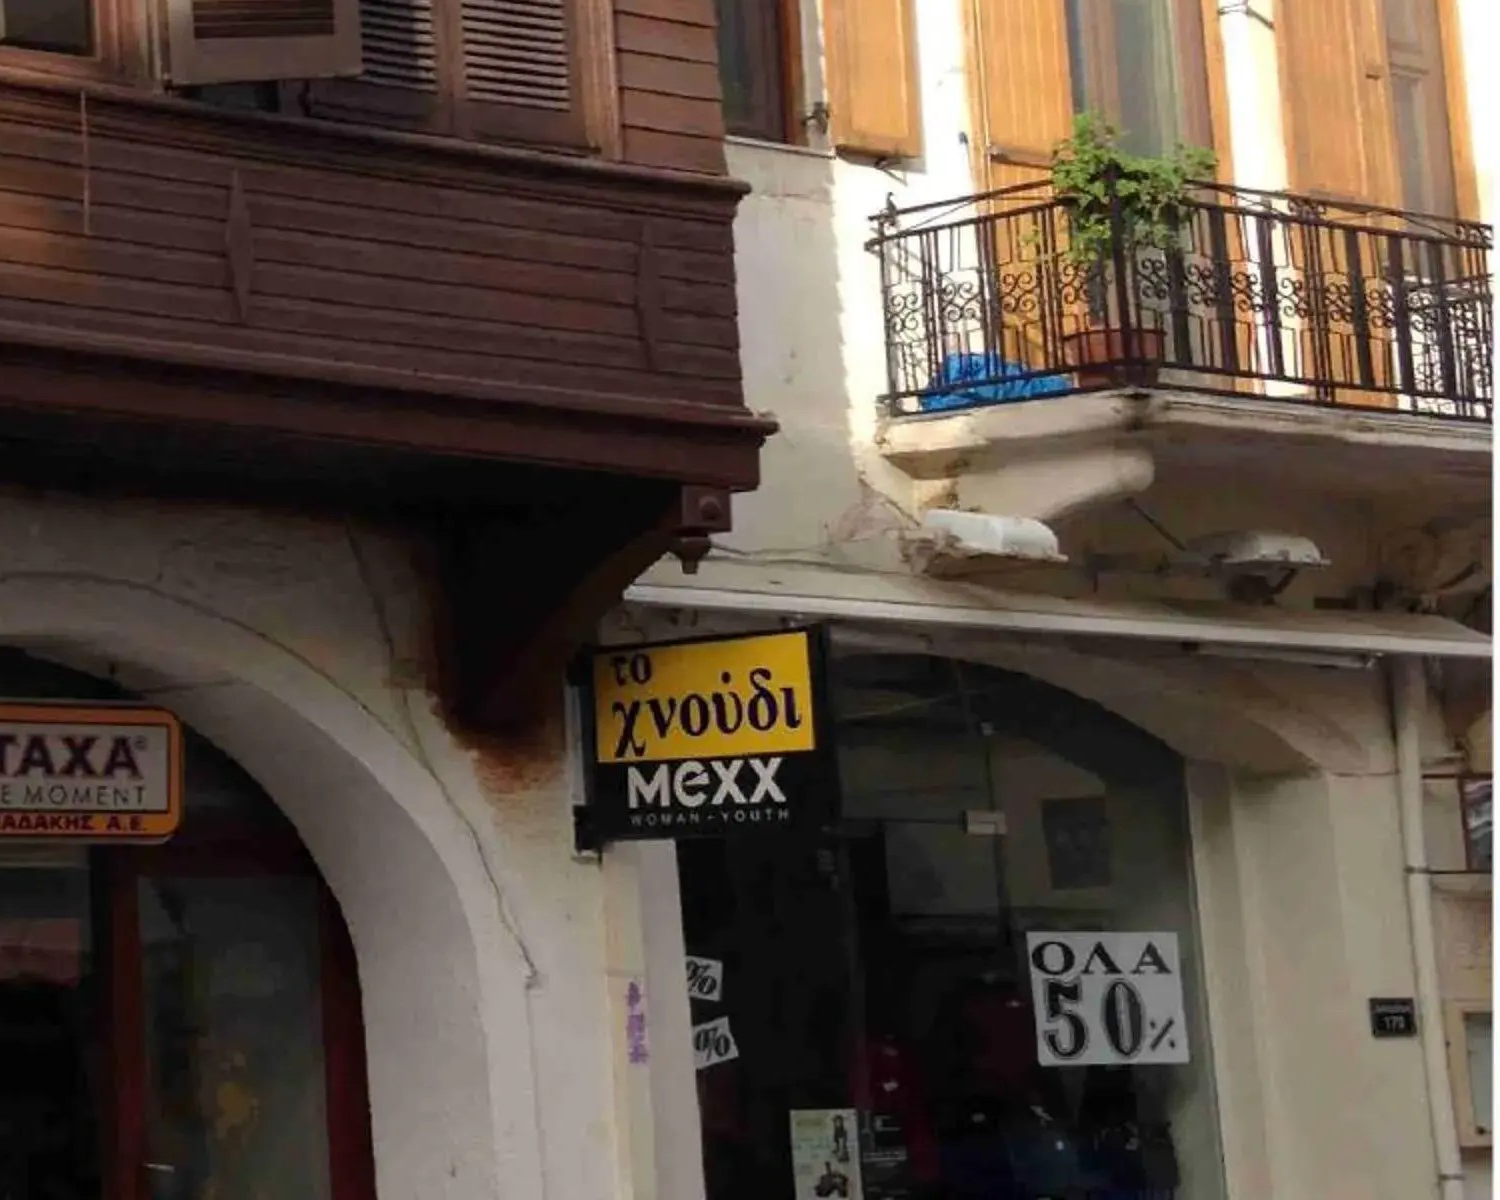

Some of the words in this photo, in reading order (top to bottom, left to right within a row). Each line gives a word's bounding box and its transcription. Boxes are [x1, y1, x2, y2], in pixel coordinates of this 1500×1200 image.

[23, 783, 146, 806] MOMENT
[629, 812, 701, 827] WOMAN
[721, 808, 790, 823] YOUTH
[1031, 941, 1173, 975] ΟΛΑ
[1043, 977, 1176, 1060] 50%
